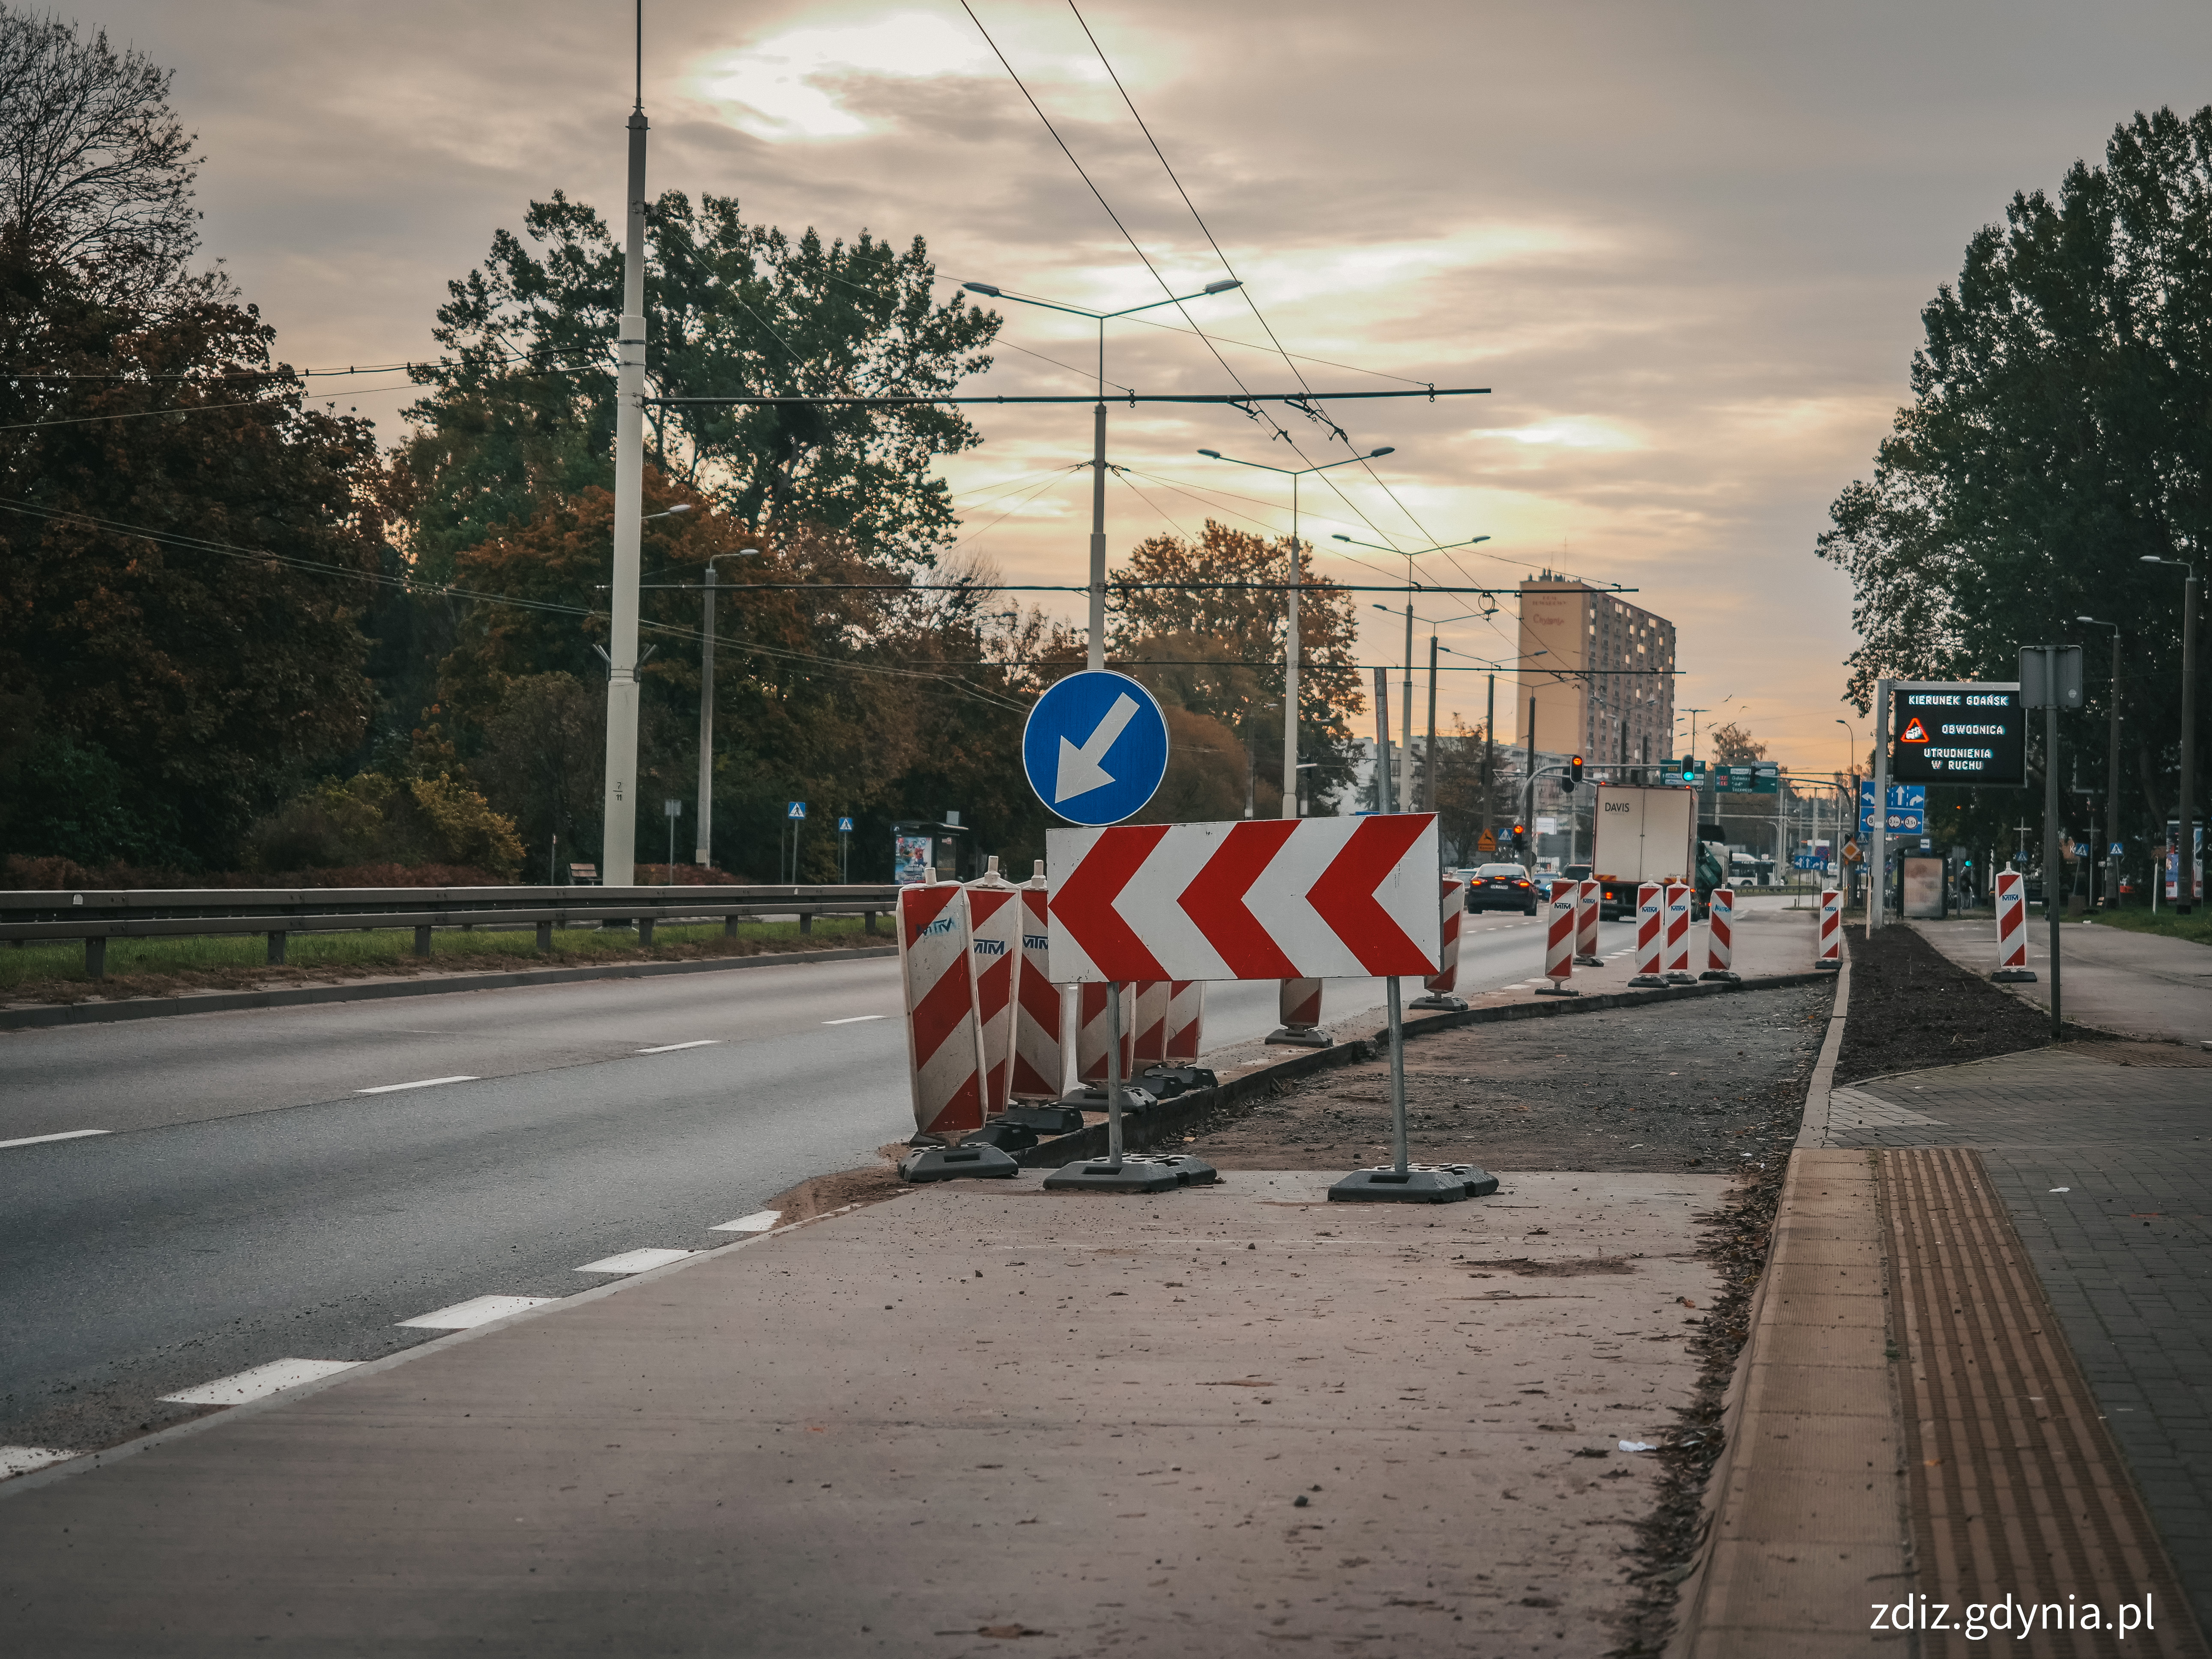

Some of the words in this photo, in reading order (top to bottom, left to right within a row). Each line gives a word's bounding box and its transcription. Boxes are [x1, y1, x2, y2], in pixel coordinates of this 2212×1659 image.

[1908, 695, 1961, 705] KIERUNEK
[1966, 694, 2009, 706] GDAŃSK
[1942, 724, 2005, 735] OBWODNICA
[1924, 748, 1993, 759] UTRUDNIENIA
[1931, 760, 1943, 769] W
[1948, 760, 1984, 770] RUCHU
[1605, 802, 1629, 813] DAVIS
